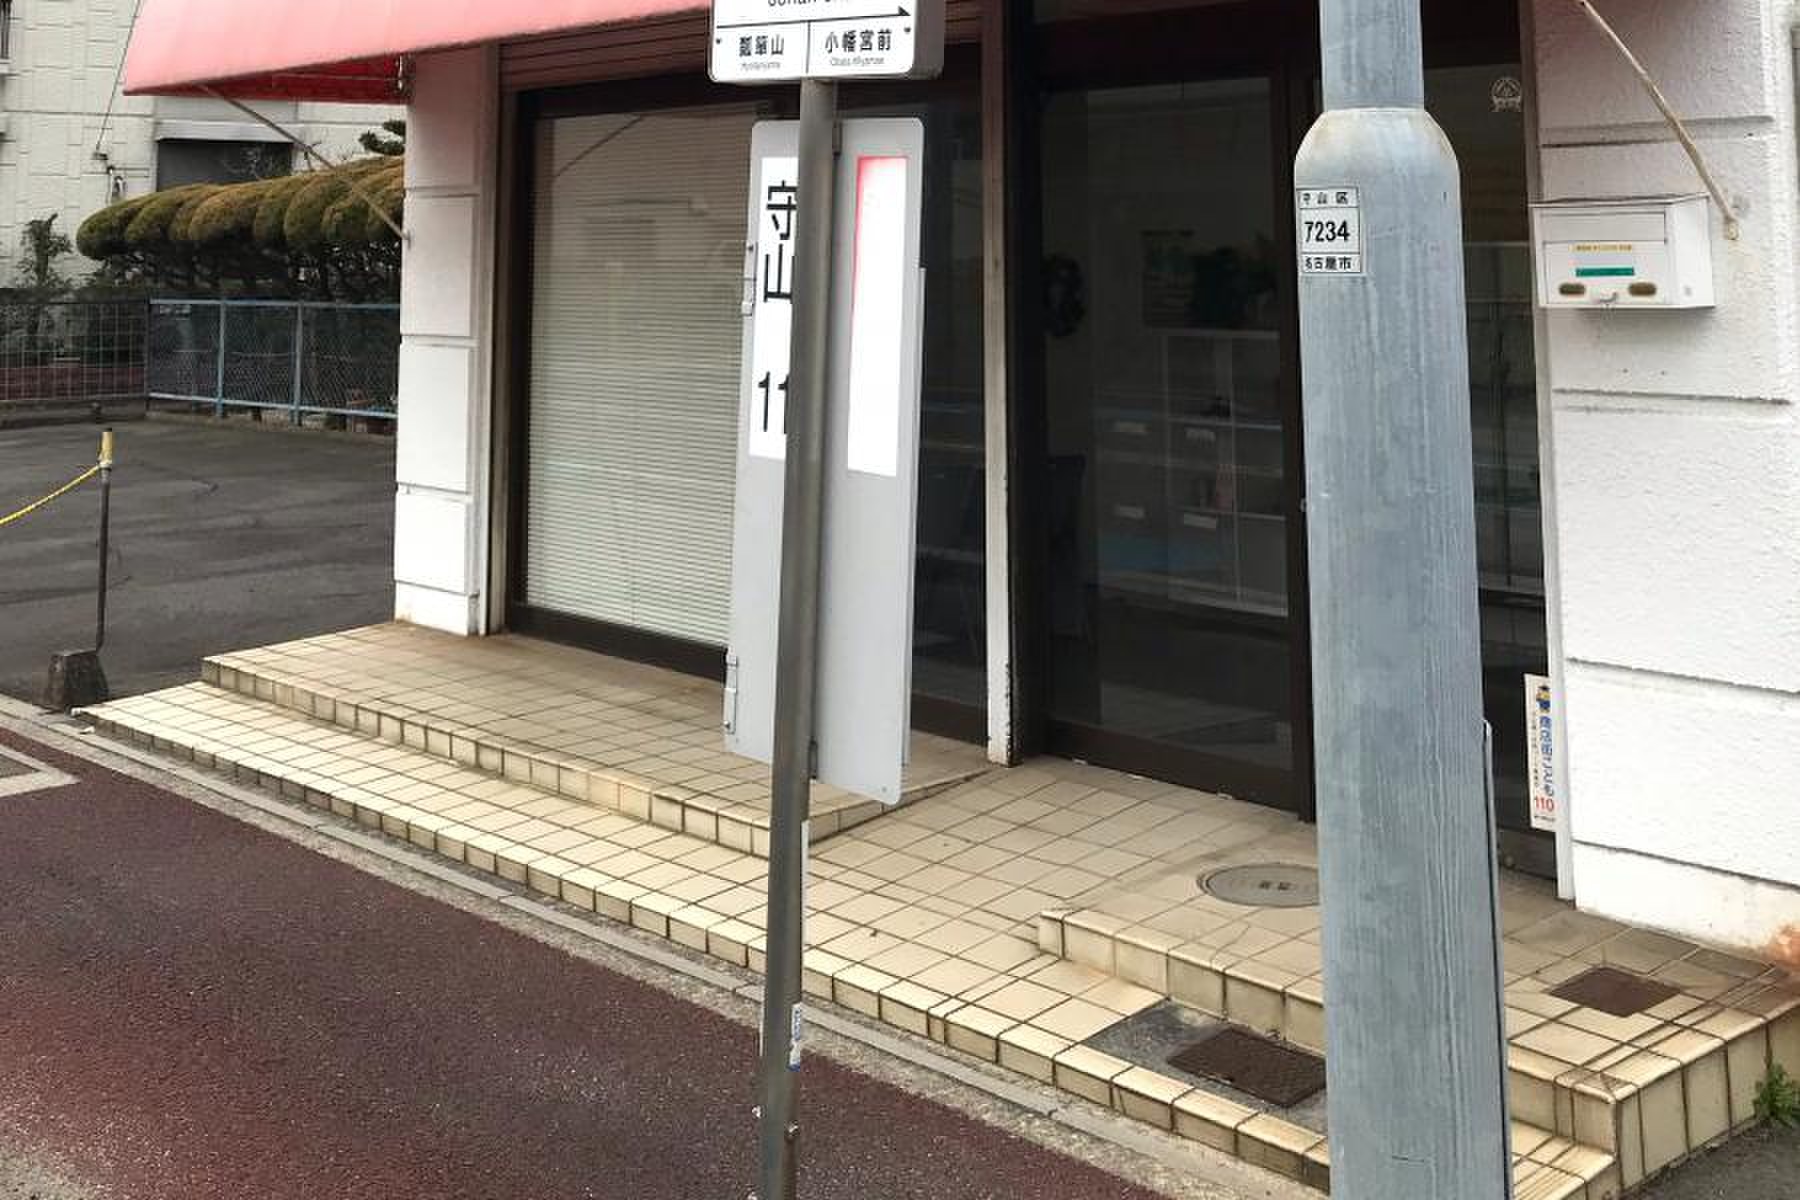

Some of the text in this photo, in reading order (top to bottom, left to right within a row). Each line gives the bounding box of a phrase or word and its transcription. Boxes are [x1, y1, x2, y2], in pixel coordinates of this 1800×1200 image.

[825, 29, 892, 54] 小幡宮前
[1304, 220, 1351, 243] 7234
[1304, 255, 1353, 271] 名古屋市
